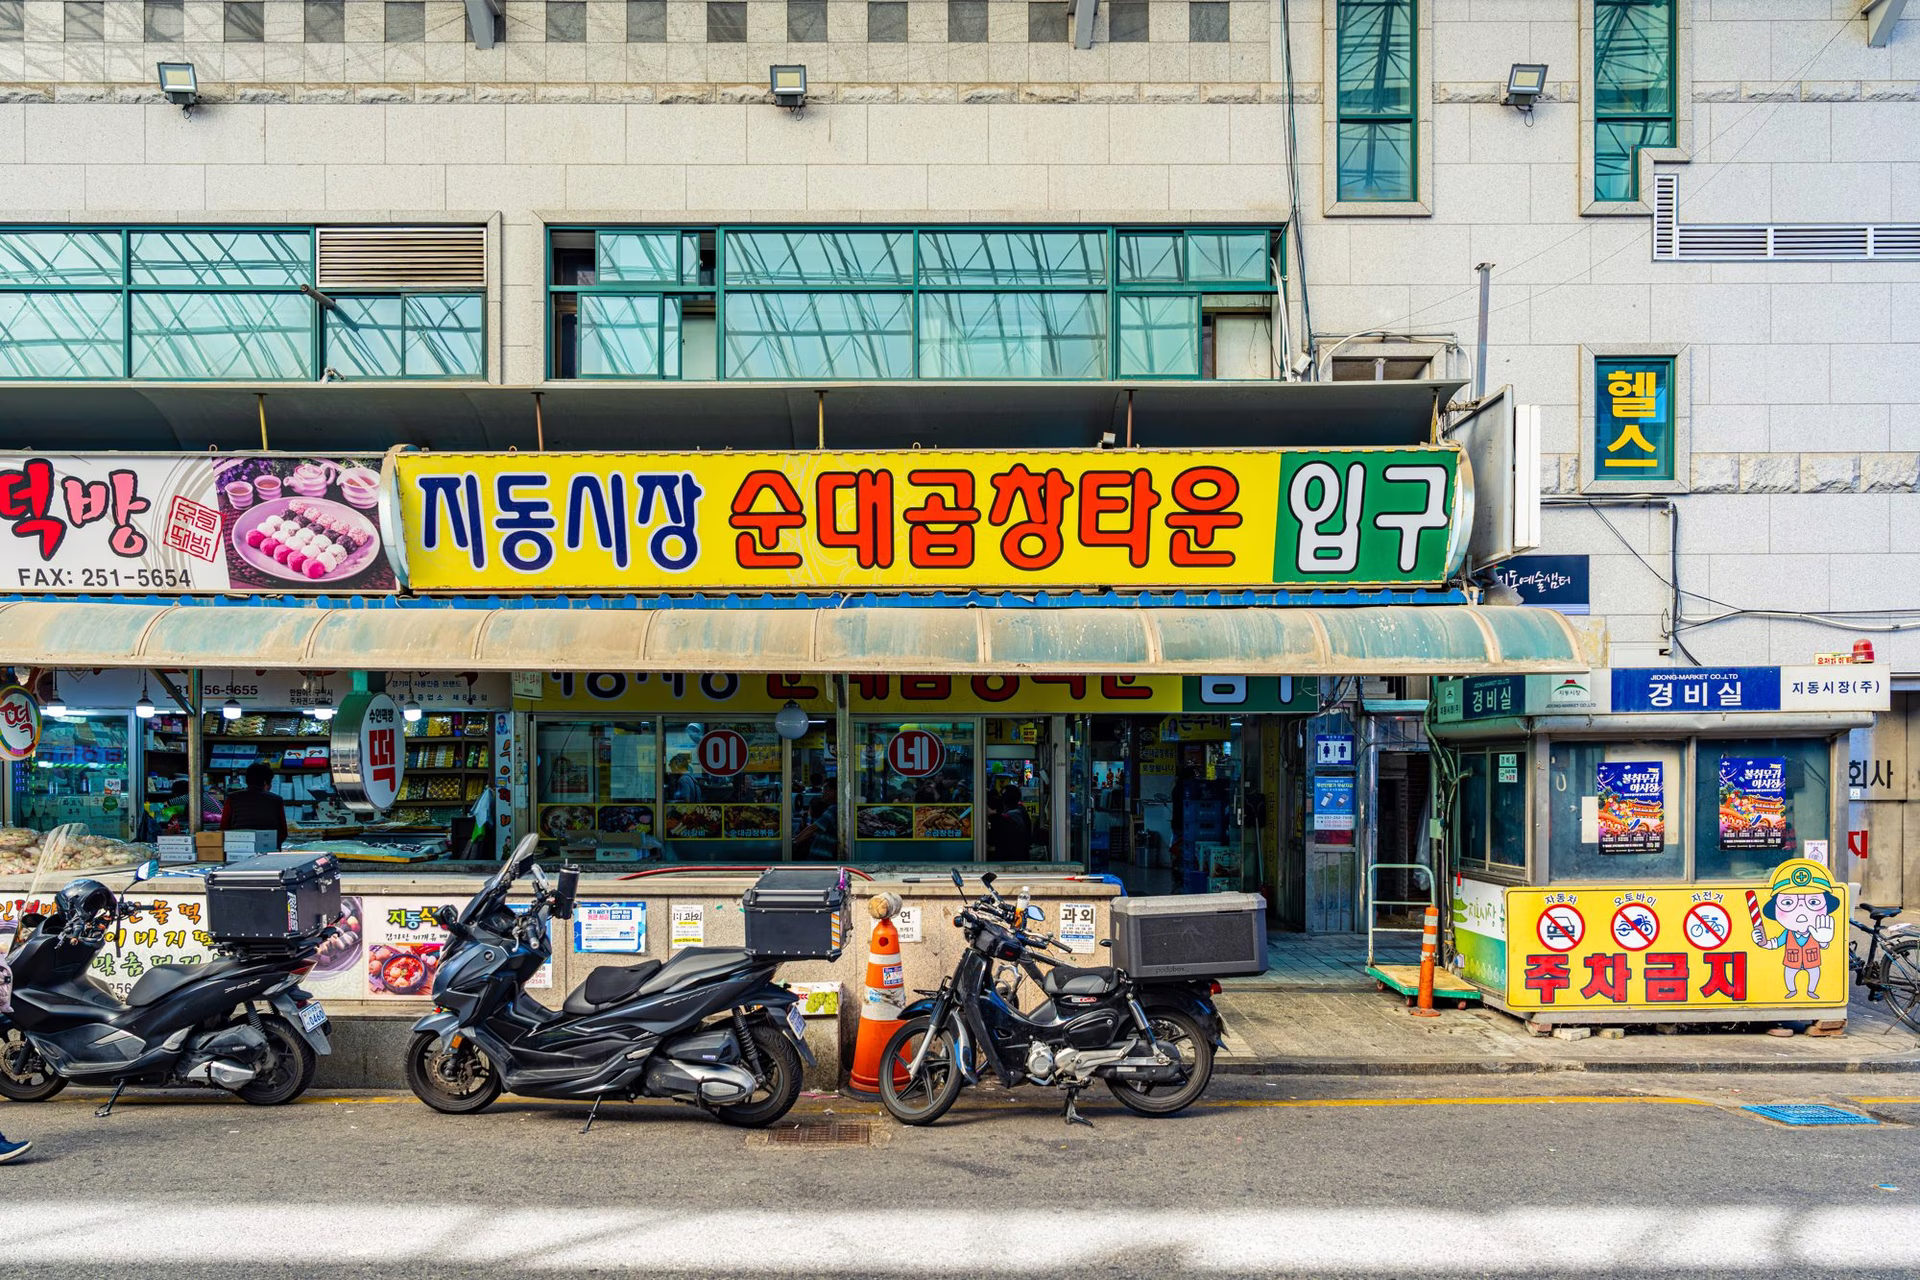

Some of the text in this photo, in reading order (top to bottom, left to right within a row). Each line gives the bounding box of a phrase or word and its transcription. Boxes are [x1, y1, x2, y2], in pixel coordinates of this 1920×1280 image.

[1604, 370, 1658, 467] 헬스
[415, 460, 1449, 575] 지동시장 순대곱창타운 입구
[18, 568, 191, 587] FAX: 251-5654
[1648, 681, 1743, 707] 경비실
[1792, 680, 1881, 695] 지동시장(주)
[1473, 686, 1512, 713] 경비실
[368, 728, 396, 793] 떡
[706, 735, 738, 770] 이
[897, 735, 929, 770] 네
[1544, 892, 1578, 905] 자동차
[1614, 891, 1658, 907] 오토바이
[1691, 891, 1725, 904] 자전거
[683, 911, 703, 921] 과외
[900, 911, 911, 924] 연
[1061, 908, 1095, 924] 과외
[1524, 951, 1748, 1004] 주차금지
